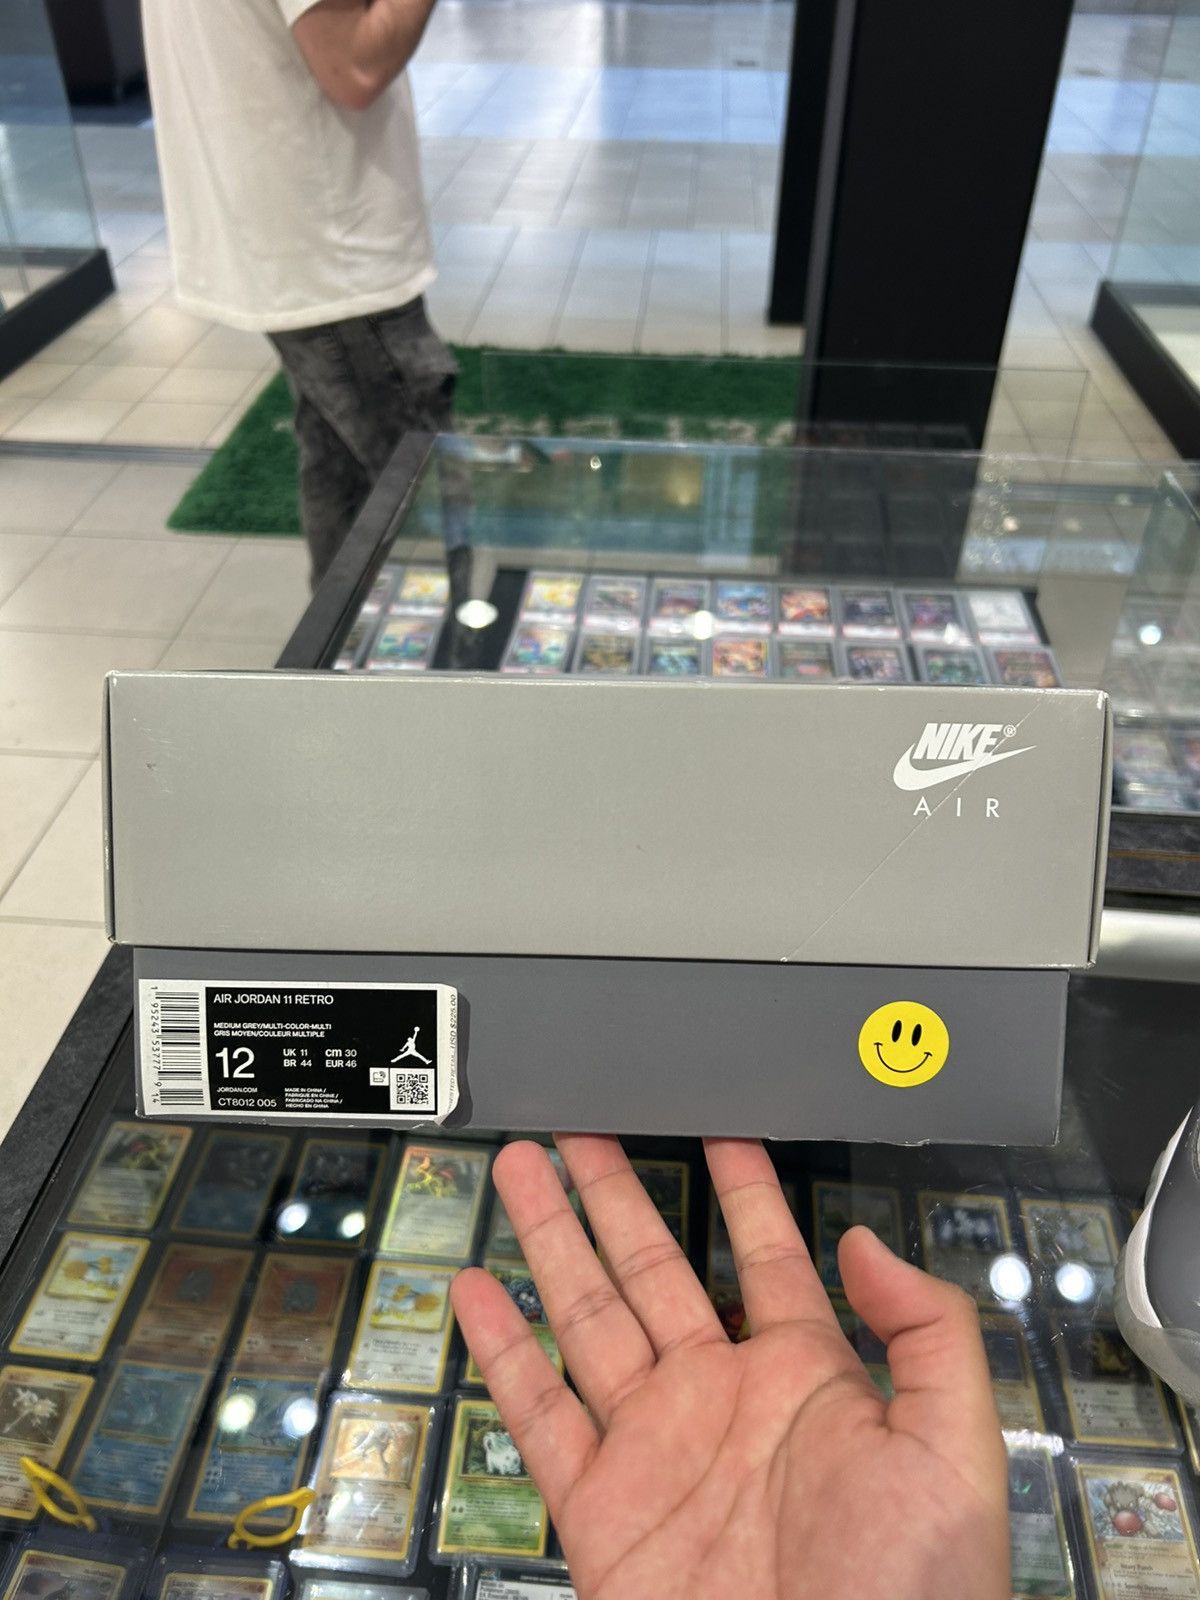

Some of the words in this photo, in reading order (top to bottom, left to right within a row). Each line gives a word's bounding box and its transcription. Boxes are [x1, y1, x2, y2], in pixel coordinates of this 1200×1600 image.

[912, 796, 1000, 818] AIR
[213, 993, 232, 1003] AIR
[234, 993, 281, 1004] JORDAN
[283, 995, 292, 1004] 11
[294, 994, 334, 1005] RETRO
[150, 1002, 160, 1034] 95243
[242, 1022, 332, 1030] GREY/MULTI-COLOR-MULTI
[231, 1030, 291, 1038] MOYEN/COULEUR
[151, 1040, 161, 1071] 53777
[283, 1048, 296, 1057] UK
[300, 1049, 308, 1057] 11
[325, 1048, 343, 1057] cm
[344, 1049, 357, 1057] 30
[215, 1046, 255, 1079] 12
[283, 1059, 297, 1067] BR
[300, 1059, 312, 1067] 44
[325, 1059, 344, 1068] EUR
[345, 1060, 357, 1068] 46
[217, 1098, 255, 1107] CT8012
[256, 1099, 278, 1107] 005
